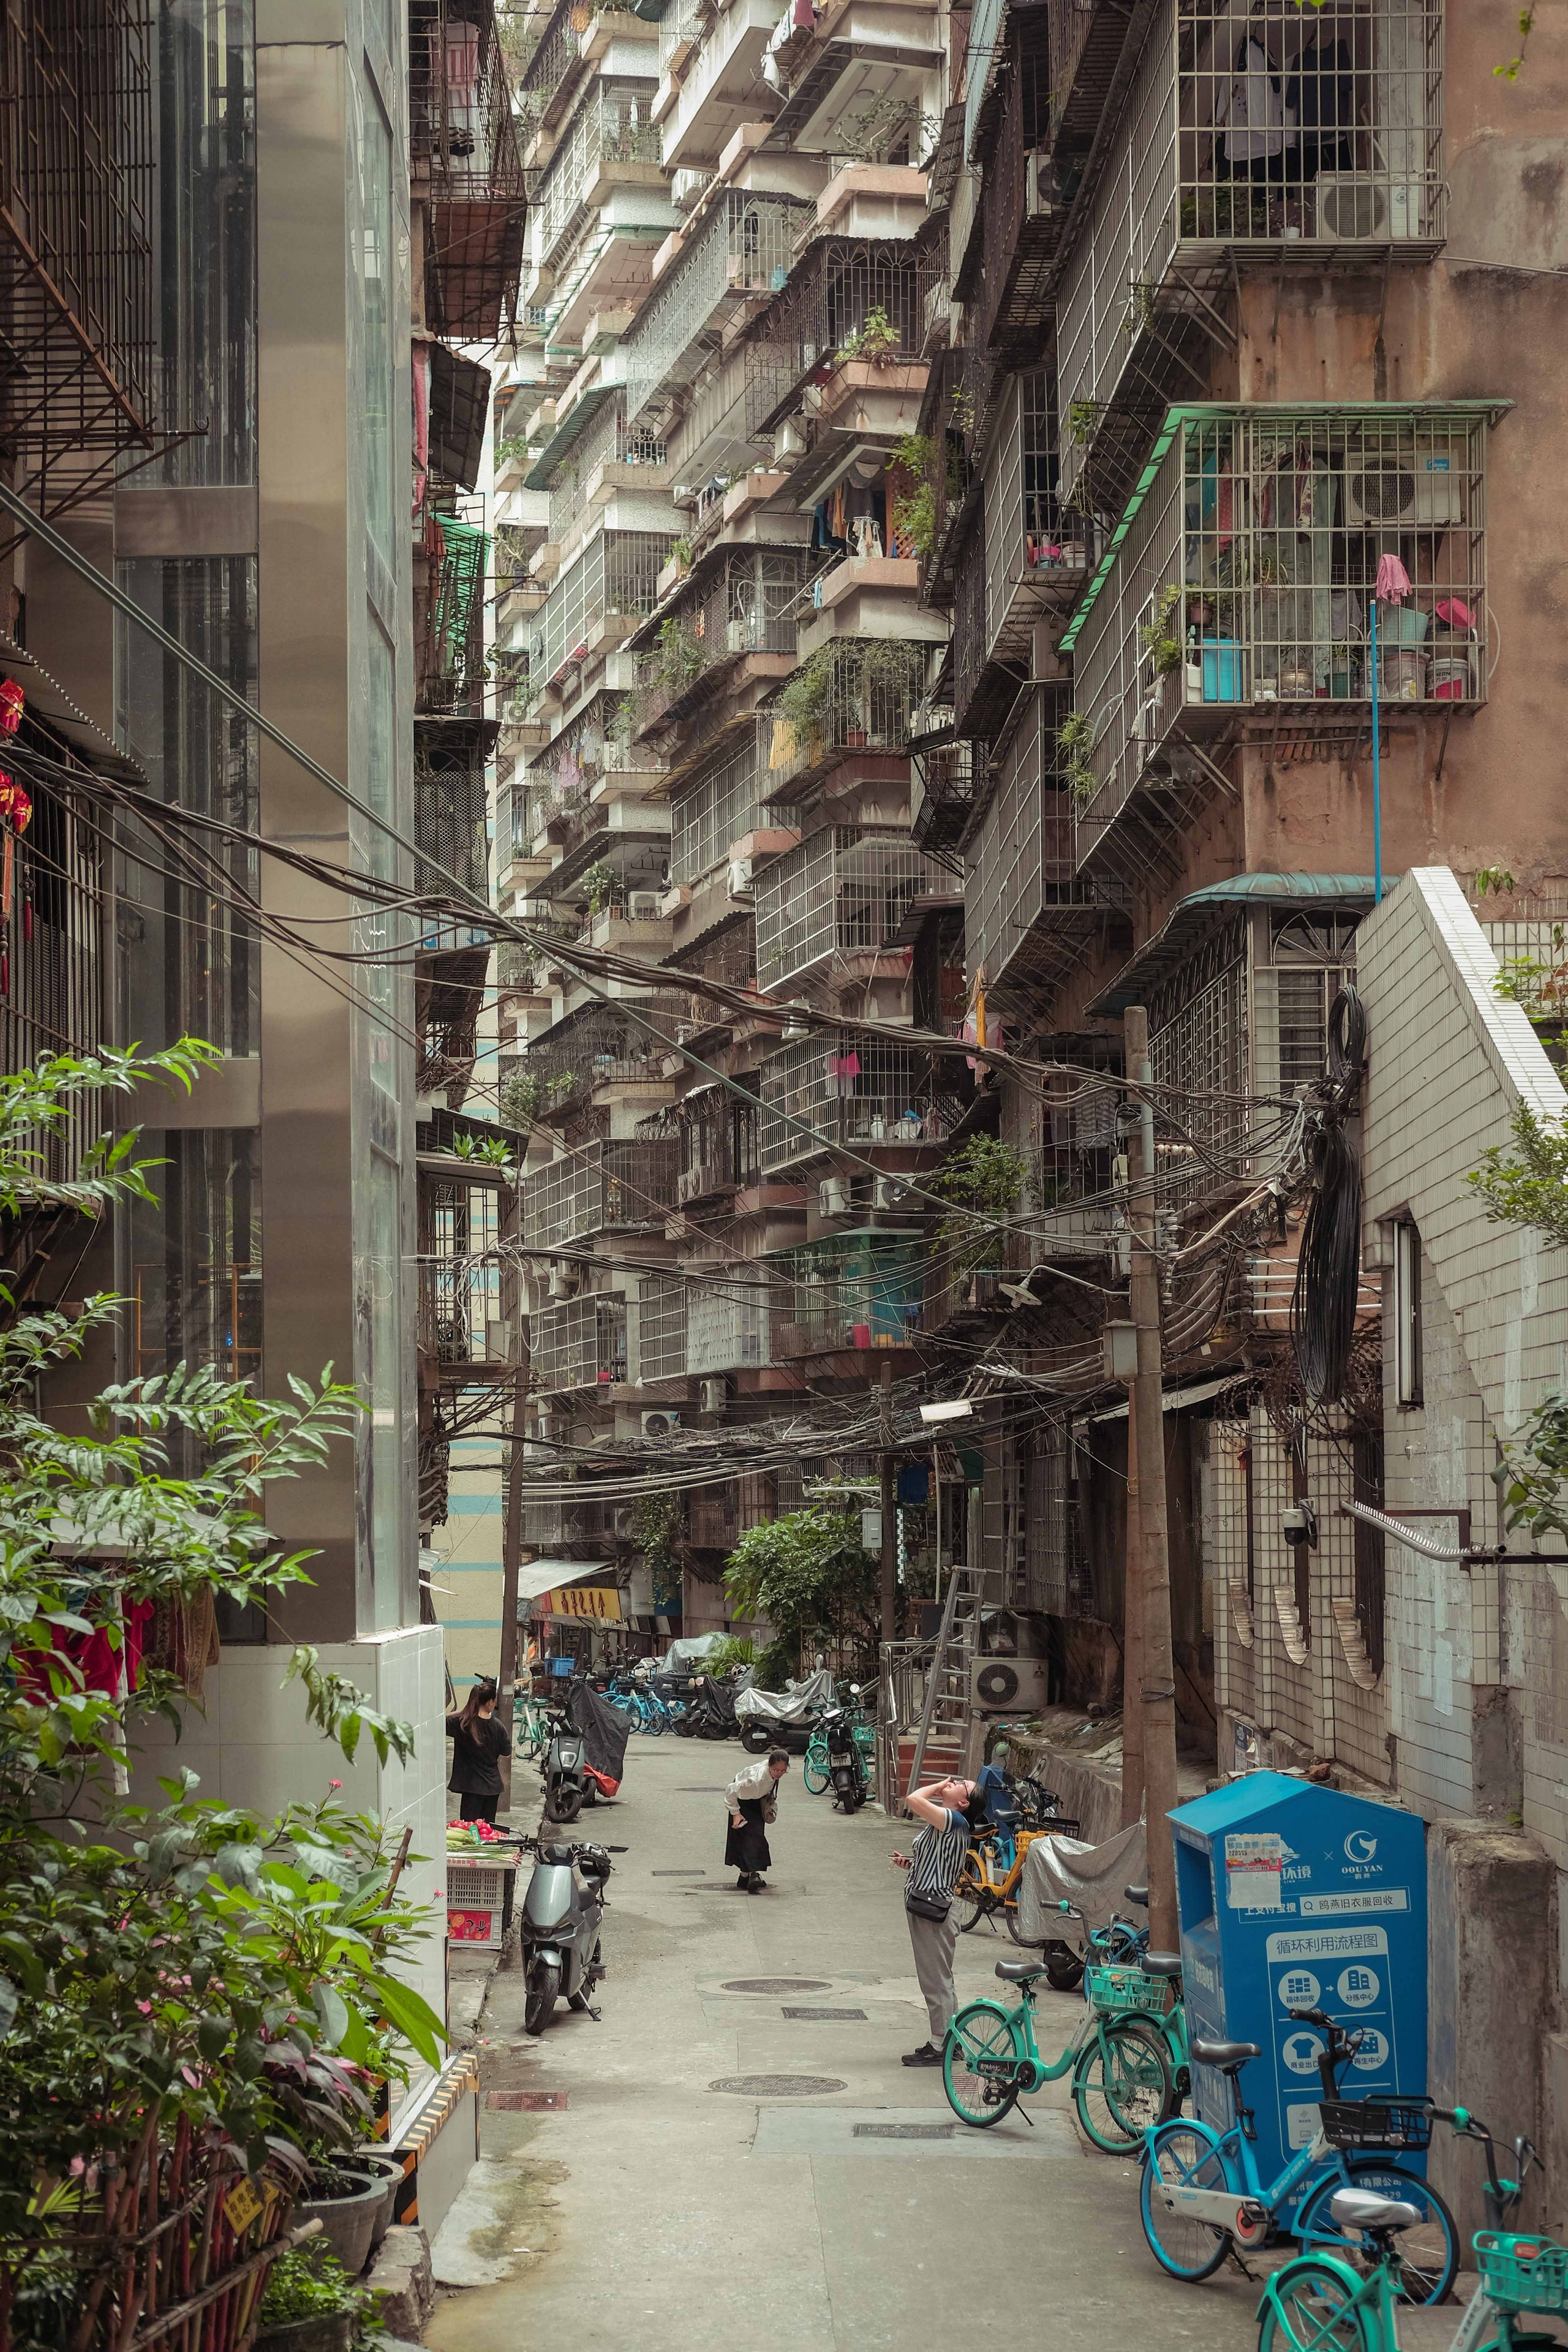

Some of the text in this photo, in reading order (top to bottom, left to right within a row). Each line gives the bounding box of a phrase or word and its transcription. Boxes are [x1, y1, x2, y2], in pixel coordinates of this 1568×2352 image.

[1281, 1866, 1311, 1880] 环境
[1319, 1895, 1393, 1910] 鸥燕旧衣服回收
[1276, 1933, 1378, 1954] 循环利用流程图
[1286, 1993, 1374, 2003] 箱体回收 分拣中心
[1291, 2056, 1383, 2069] 商业出口 再生中心
